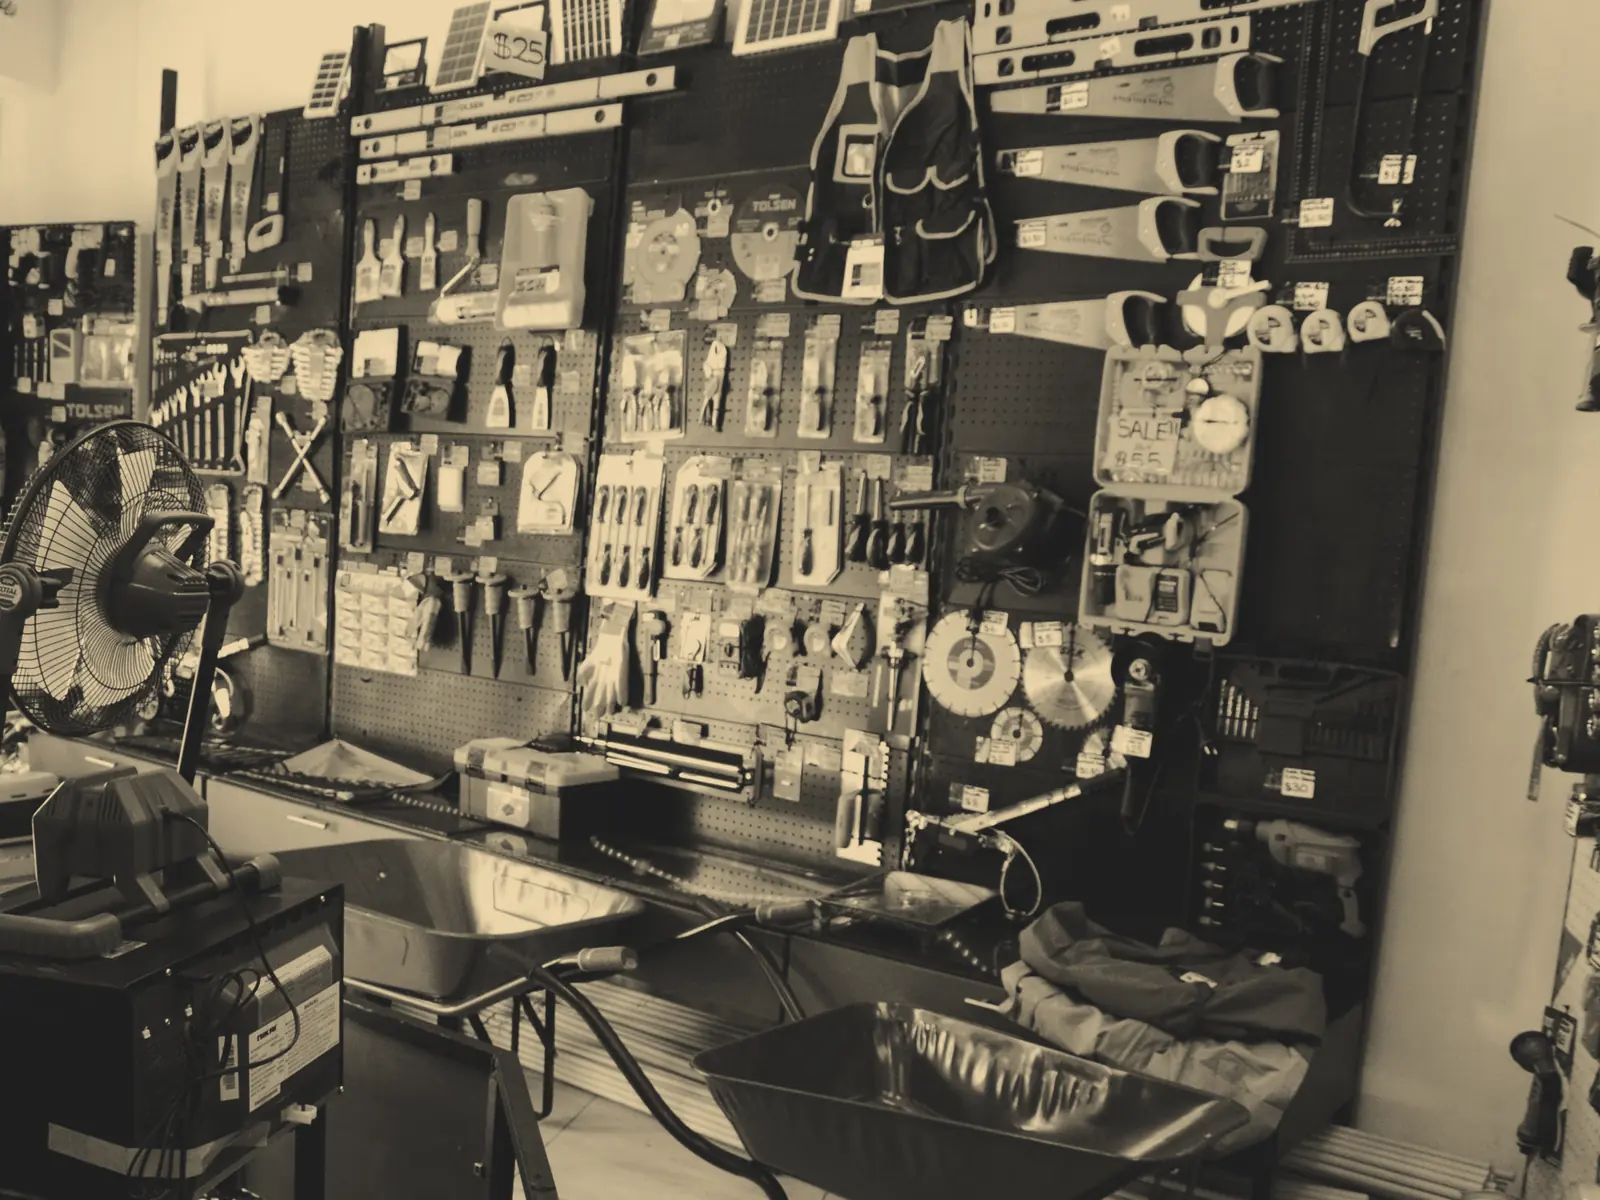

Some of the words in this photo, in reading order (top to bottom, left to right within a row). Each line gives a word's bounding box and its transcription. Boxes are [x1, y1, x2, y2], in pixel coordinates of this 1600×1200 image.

[493, 32, 544, 65] $25
[752, 198, 797, 213] TOLSEN
[66, 403, 125, 418] TOLSEN
[1285, 782, 1309, 793] $30
